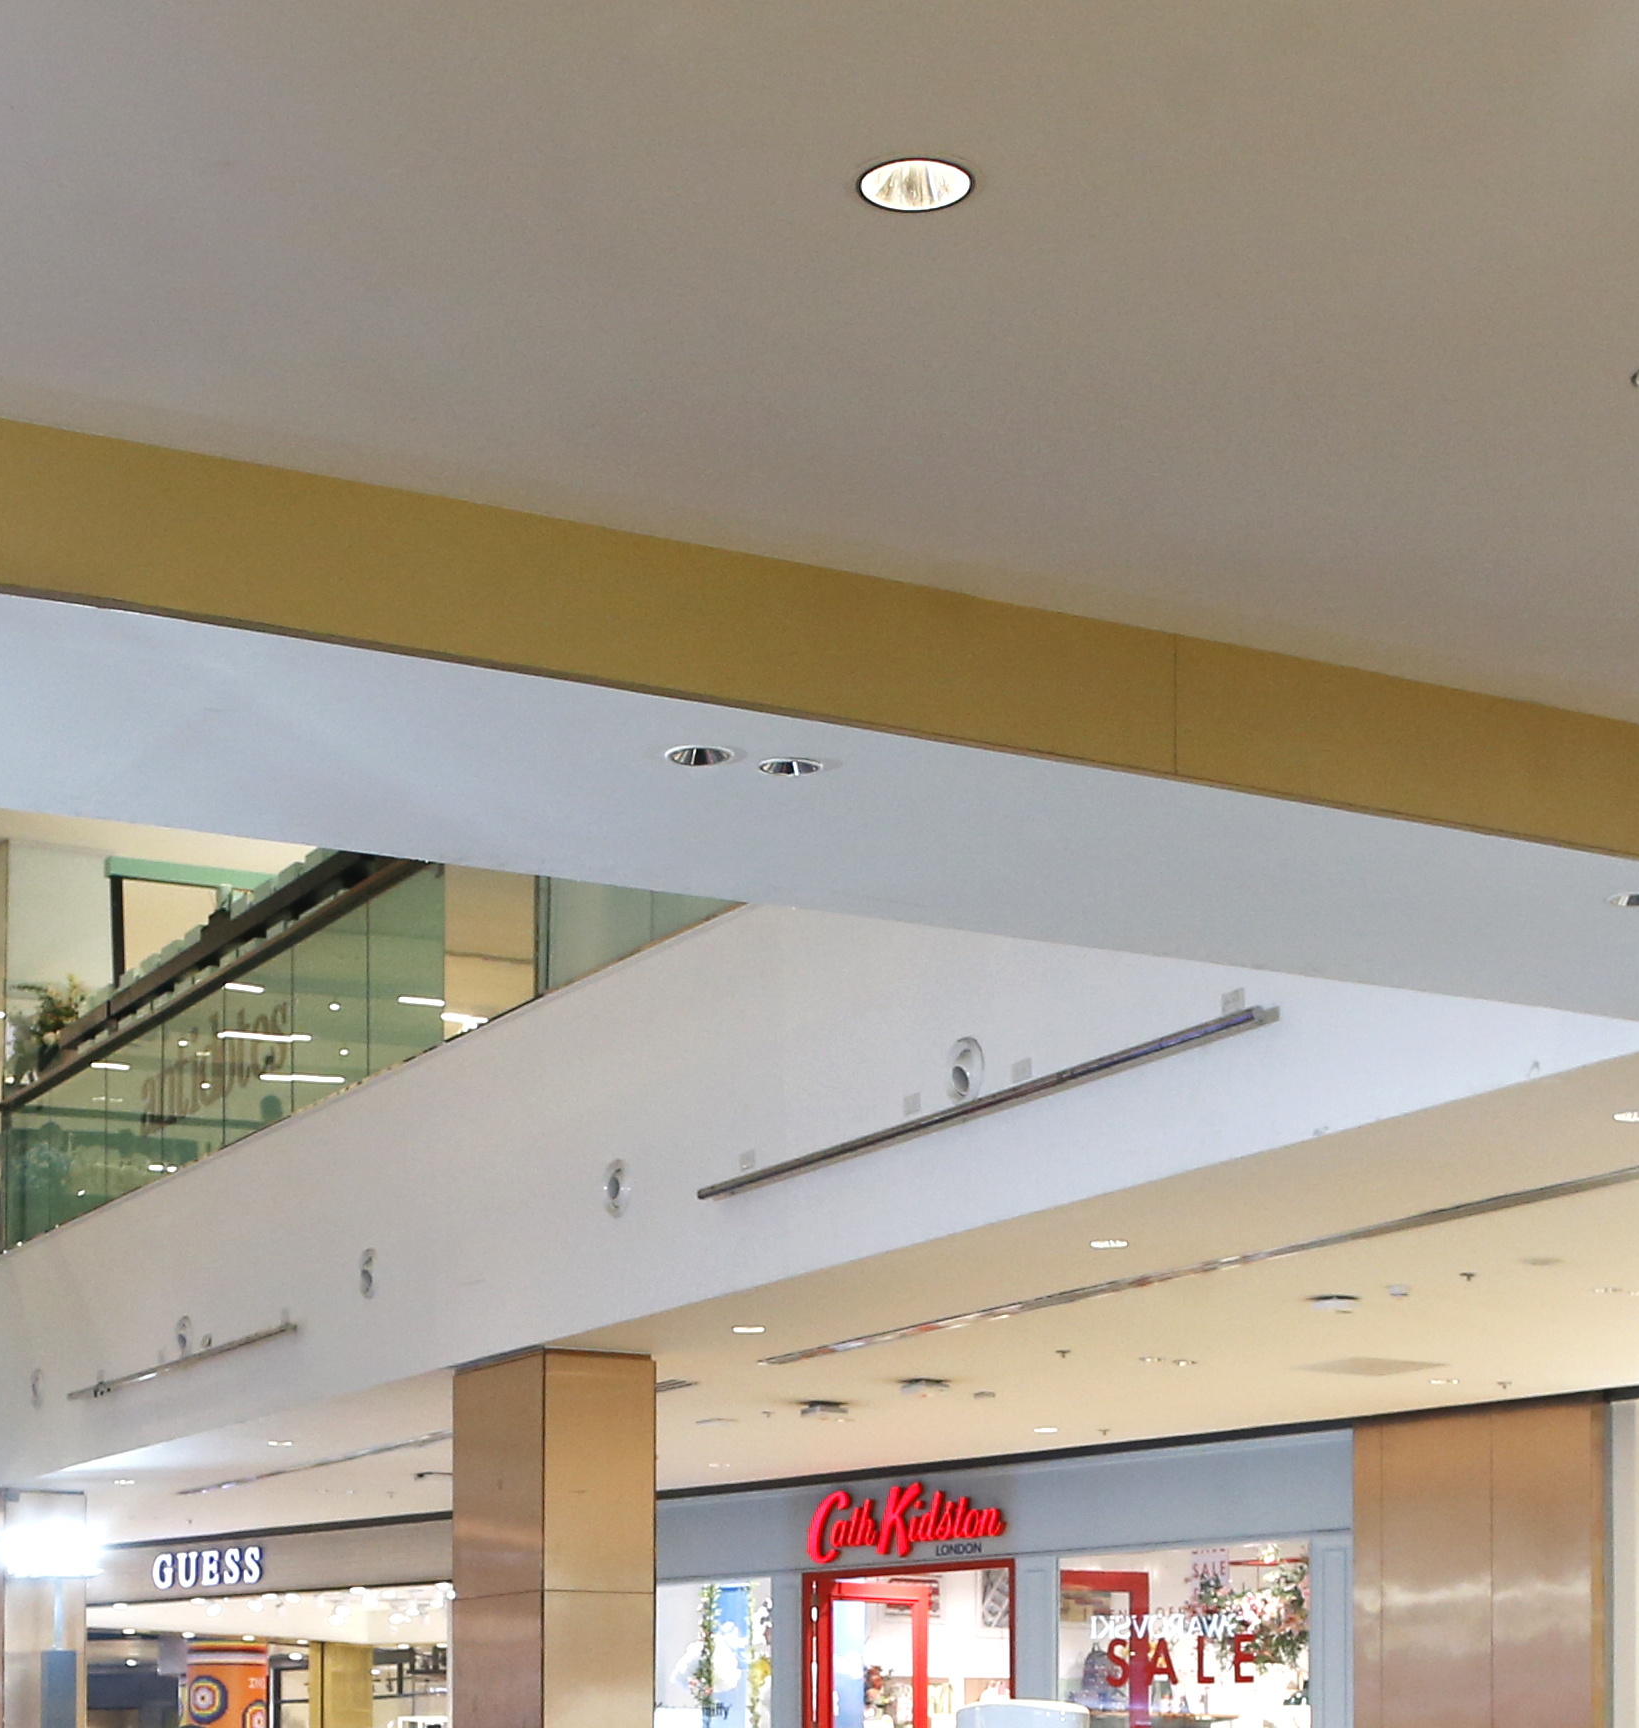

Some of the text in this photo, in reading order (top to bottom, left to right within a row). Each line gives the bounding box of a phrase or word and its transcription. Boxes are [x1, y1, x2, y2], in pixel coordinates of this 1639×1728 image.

[807, 1481, 1006, 1564] Cath Kidston
[152, 1546, 262, 1590] GUESS
[936, 1543, 982, 1556] LONDON
[1191, 1560, 1227, 1578] SALE
[1106, 1634, 1255, 1688] SALE
